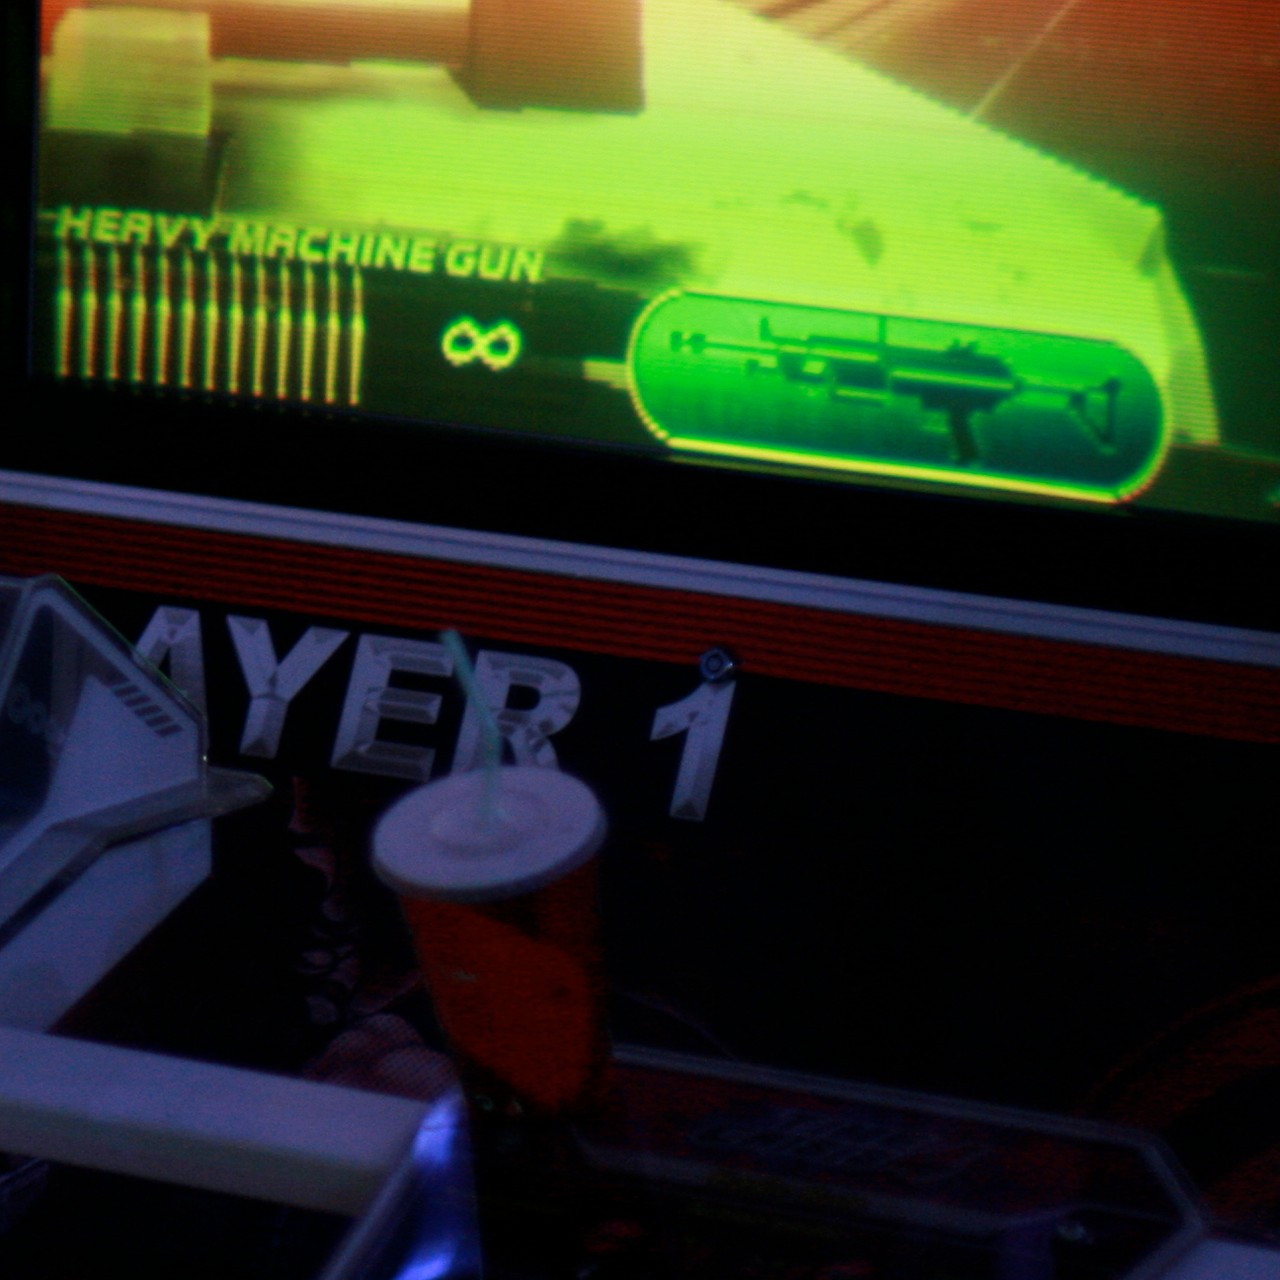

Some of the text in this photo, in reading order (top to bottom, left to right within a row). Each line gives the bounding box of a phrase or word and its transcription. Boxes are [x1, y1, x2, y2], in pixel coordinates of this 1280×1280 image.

[54, 207, 543, 284] HEAVY MACHINE GUN
[648, 670, 738, 822] 1
